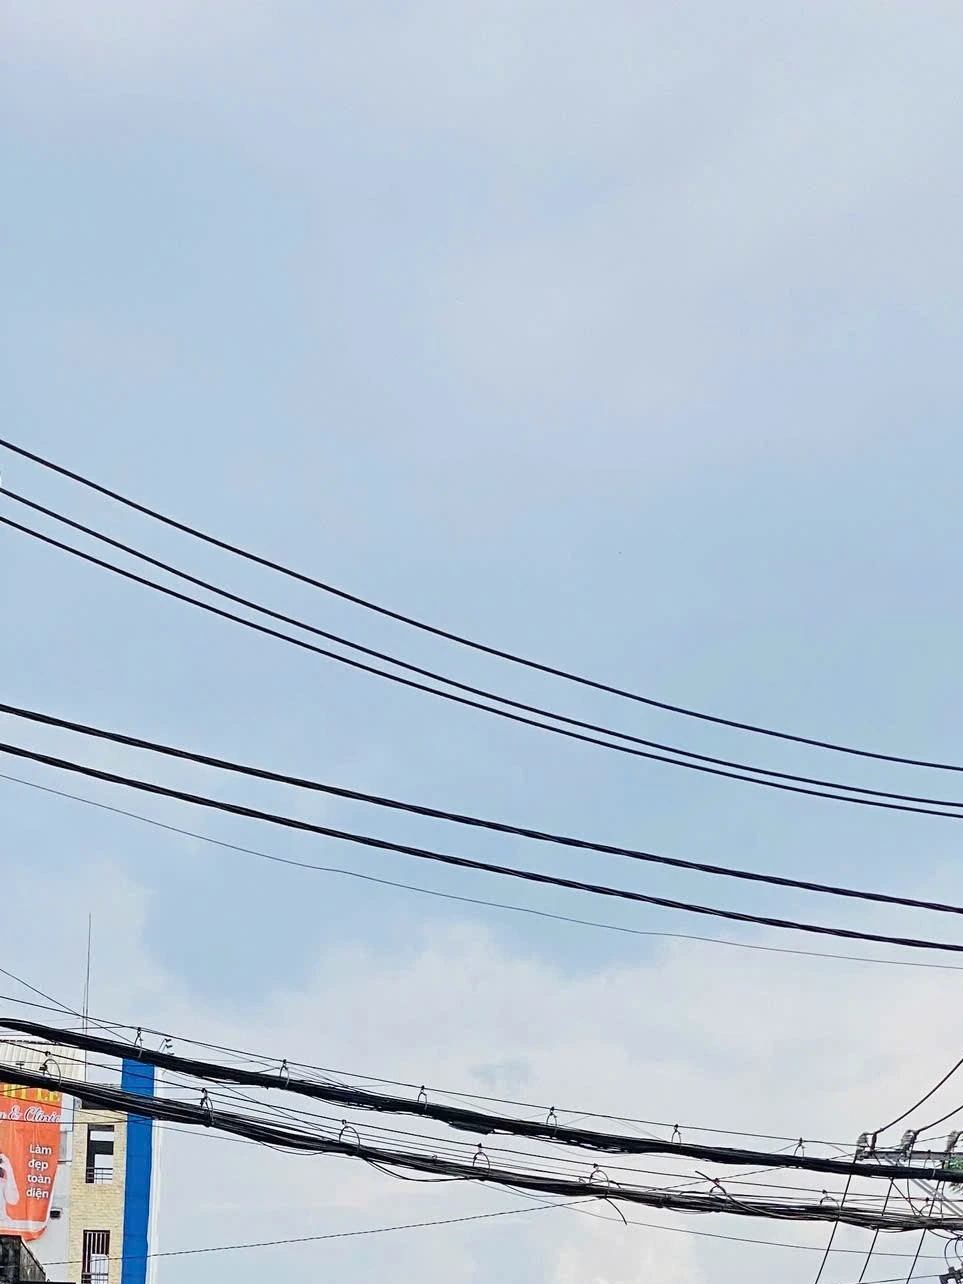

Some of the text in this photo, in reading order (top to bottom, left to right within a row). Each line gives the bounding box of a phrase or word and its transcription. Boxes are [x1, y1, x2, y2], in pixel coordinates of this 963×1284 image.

[24, 1105, 61, 1123] Clinic
[29, 1143, 52, 1155] Làm
[28, 1157, 49, 1171] đẹp
[27, 1173, 51, 1184] toàn
[26, 1187, 49, 1199] diện
